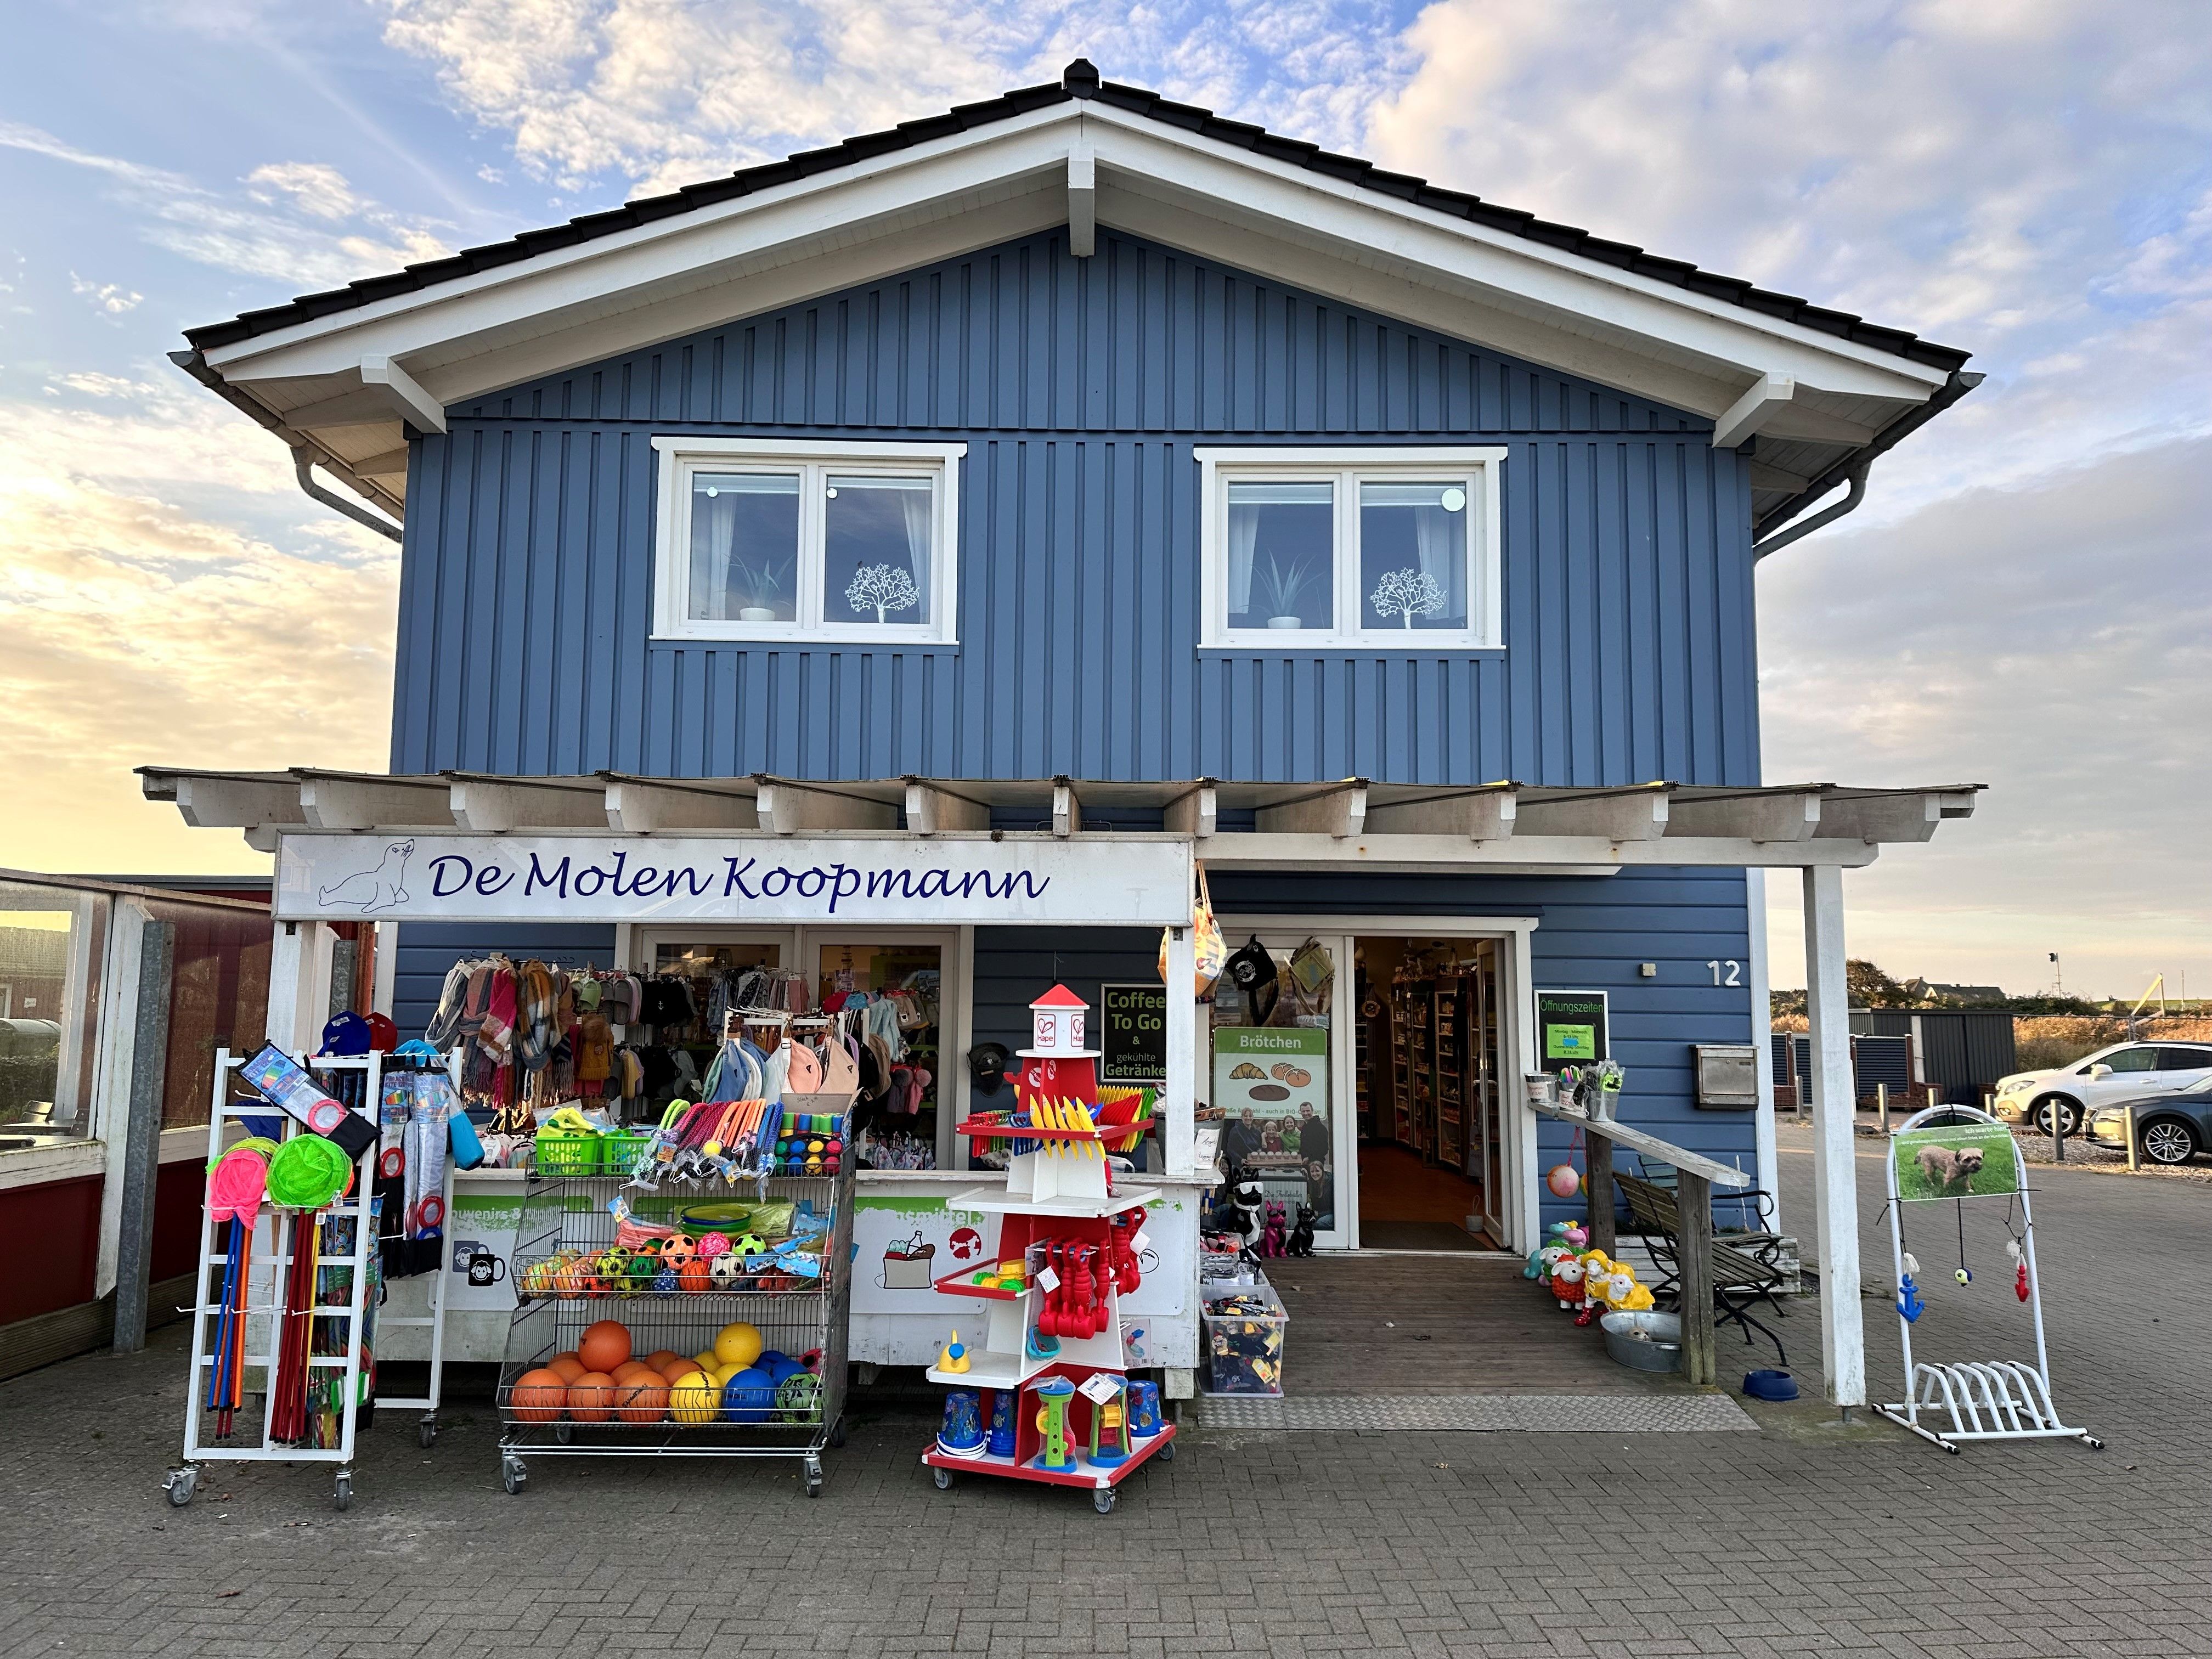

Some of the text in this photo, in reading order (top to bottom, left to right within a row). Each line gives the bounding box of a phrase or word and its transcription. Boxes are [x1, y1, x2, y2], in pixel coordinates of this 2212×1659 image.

[428, 852, 1050, 913] De Molen Koopmann
[1707, 960, 1741, 986] 12
[1107, 992, 1166, 1008] Coffee
[1540, 997, 1604, 1015] Öffnungszeiten
[1111, 1013, 1161, 1030] To Go
[1132, 1036, 1141, 1045] &
[1239, 1034, 1302, 1049] Brötchen
[1116, 1052, 1156, 1064] gekühlte
[1105, 1064, 1166, 1076] Getränke
[452, 1207, 509, 1220] ouvenirs
